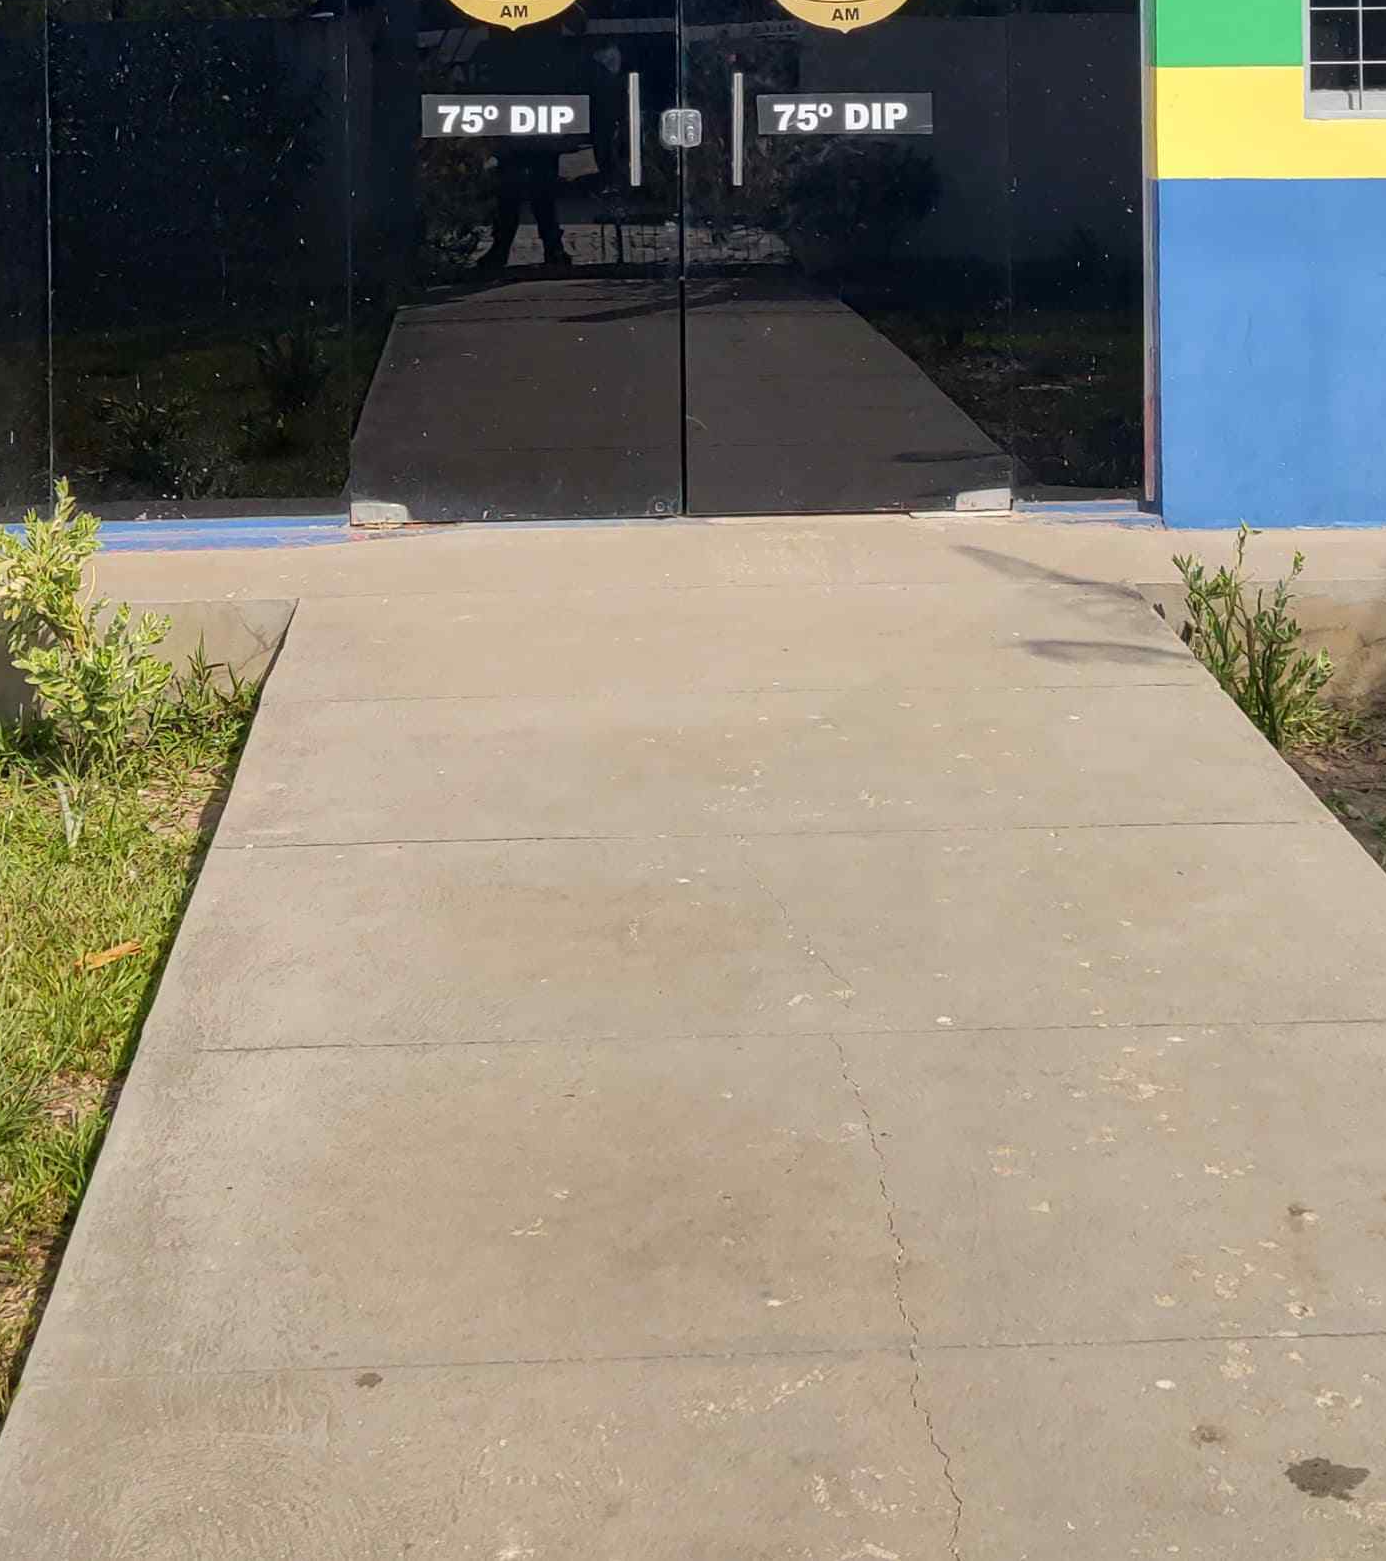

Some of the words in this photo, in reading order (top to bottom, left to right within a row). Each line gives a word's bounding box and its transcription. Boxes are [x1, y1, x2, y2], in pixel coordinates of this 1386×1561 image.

[499, 4, 529, 19] AM
[831, 7, 861, 22] AM
[510, 105, 575, 134] DIP
[844, 102, 909, 131] DIP
